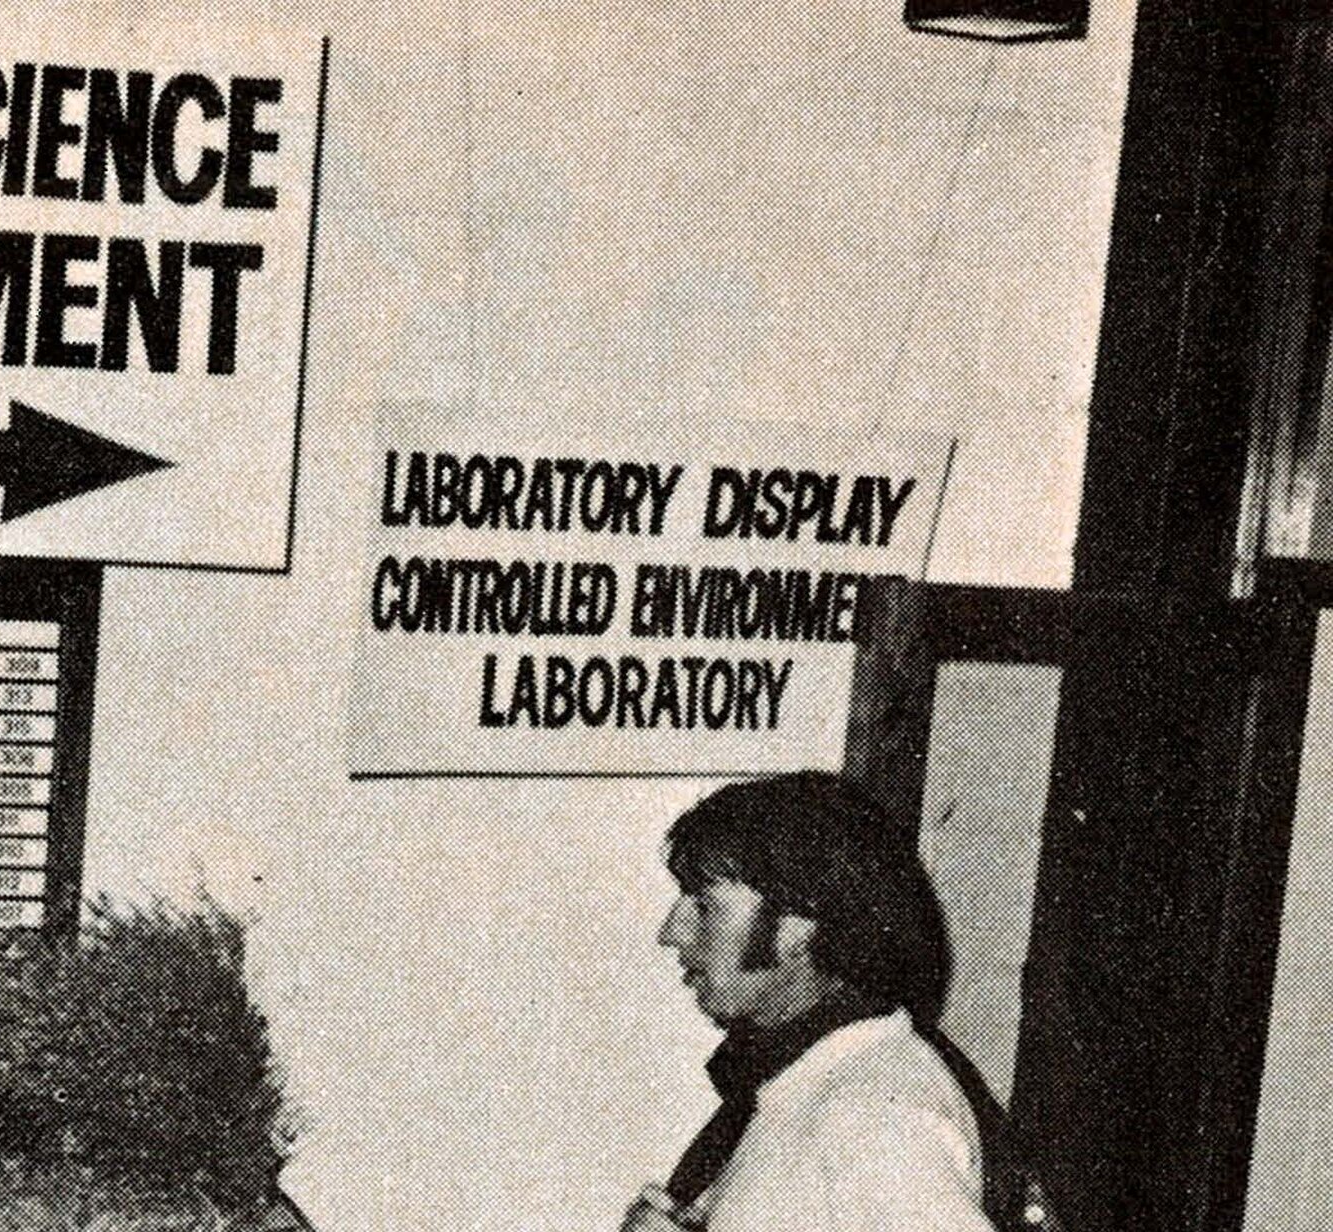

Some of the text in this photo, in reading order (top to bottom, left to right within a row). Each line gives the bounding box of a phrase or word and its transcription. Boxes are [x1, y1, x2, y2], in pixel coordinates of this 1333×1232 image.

[380, 450, 916, 548] LABORATORY DISPLAY
[370, 556, 855, 642] CONTROLLED ENVIRONME
[478, 652, 793, 731] LABORATORY
